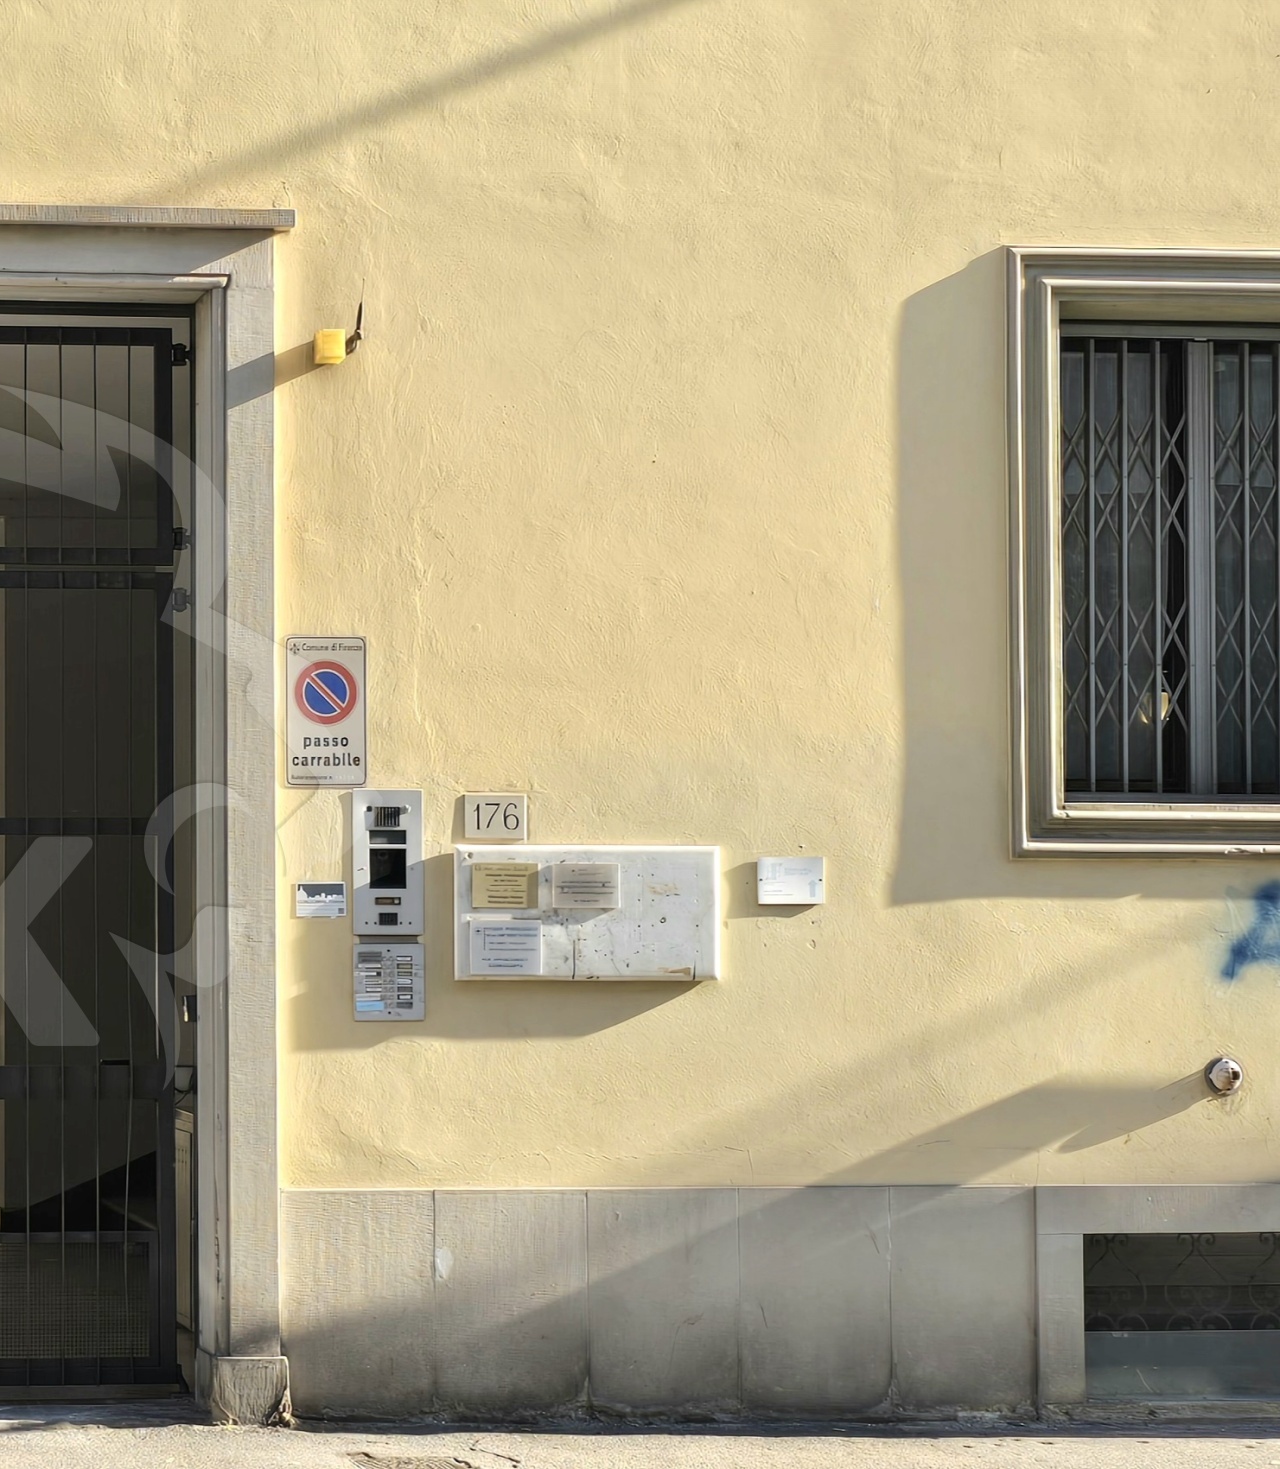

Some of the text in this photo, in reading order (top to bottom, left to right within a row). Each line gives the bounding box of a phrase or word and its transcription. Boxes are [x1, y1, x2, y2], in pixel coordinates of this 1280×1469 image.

[302, 643, 362, 651] Comune di Firenze
[303, 737, 349, 749] passo
[292, 752, 361, 767] carrabile
[473, 802, 520, 831] 176
